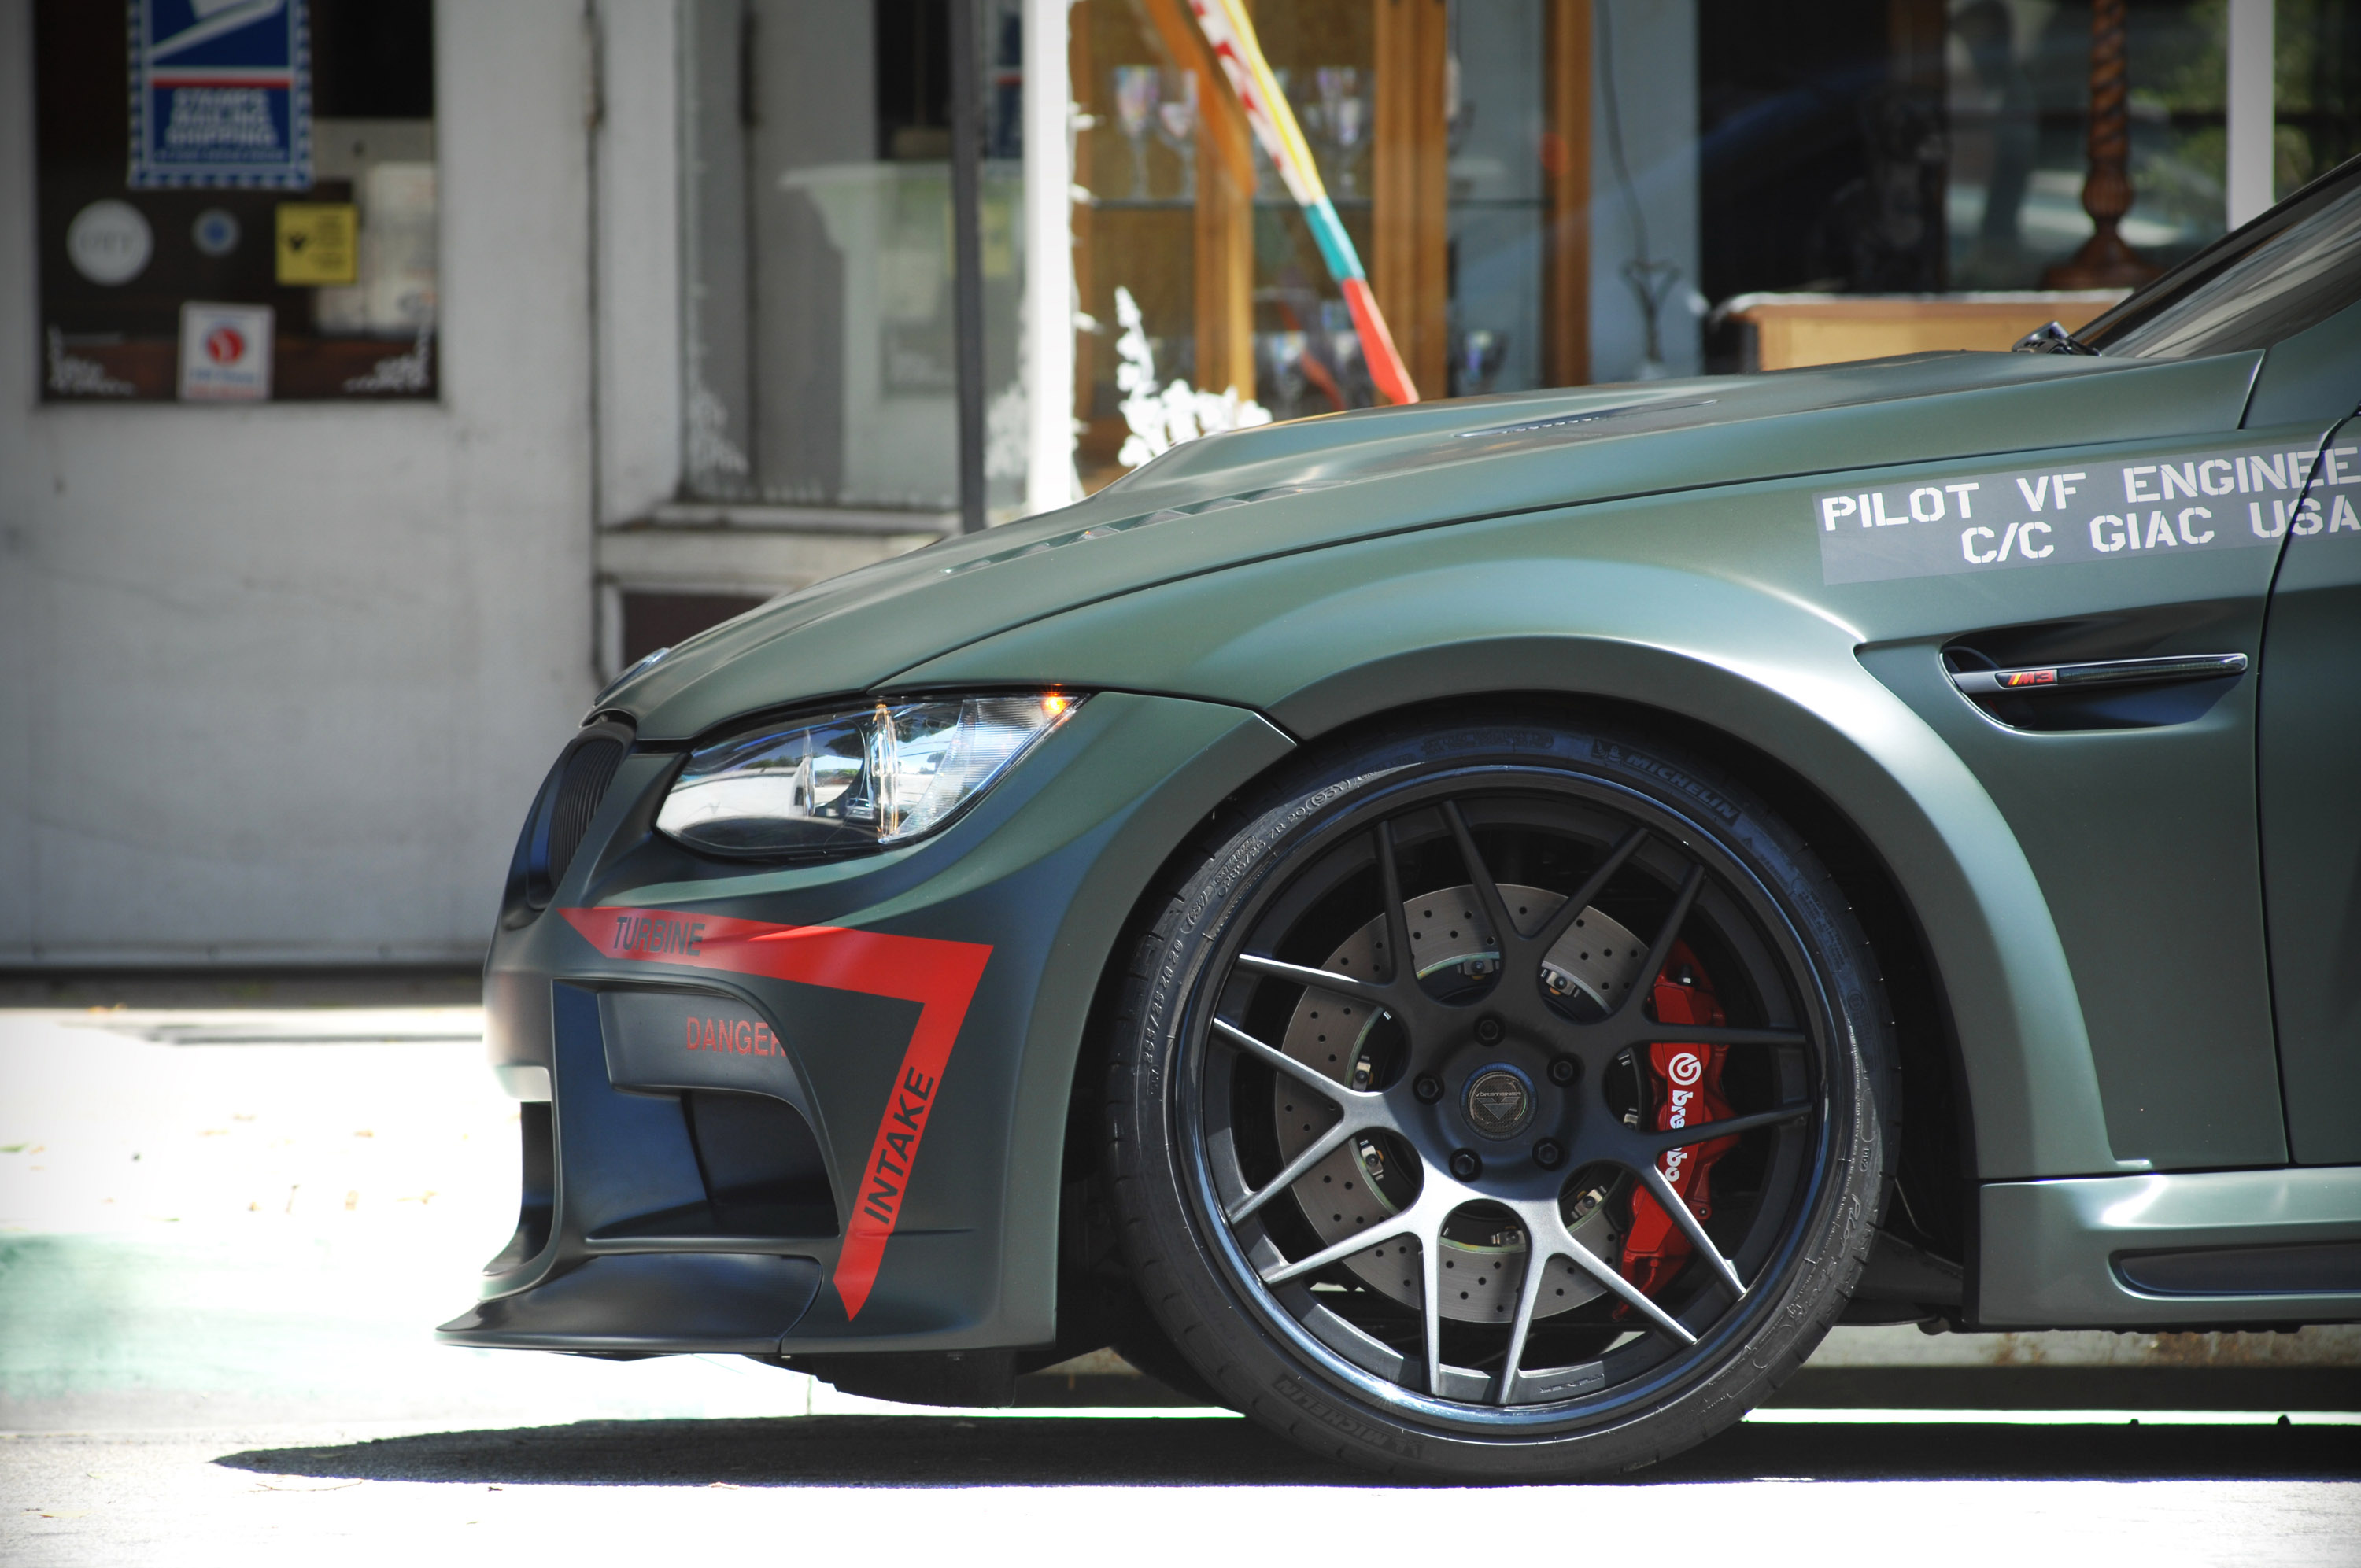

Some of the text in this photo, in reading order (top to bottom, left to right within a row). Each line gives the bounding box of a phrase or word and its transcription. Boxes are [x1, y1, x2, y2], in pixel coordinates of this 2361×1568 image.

[1822, 482, 1979, 531] PILOT
[2016, 472, 2086, 512] VF
[1961, 494, 2361, 563] C/C GIAC USA
[1626, 754, 1738, 819] MICHELIN
[614, 917, 705, 956] TURBINE
[863, 1066, 934, 1225] INTAKE
[1665, 1090, 1694, 1182] brebo
[1276, 1378, 1388, 1446] MICHELIN
